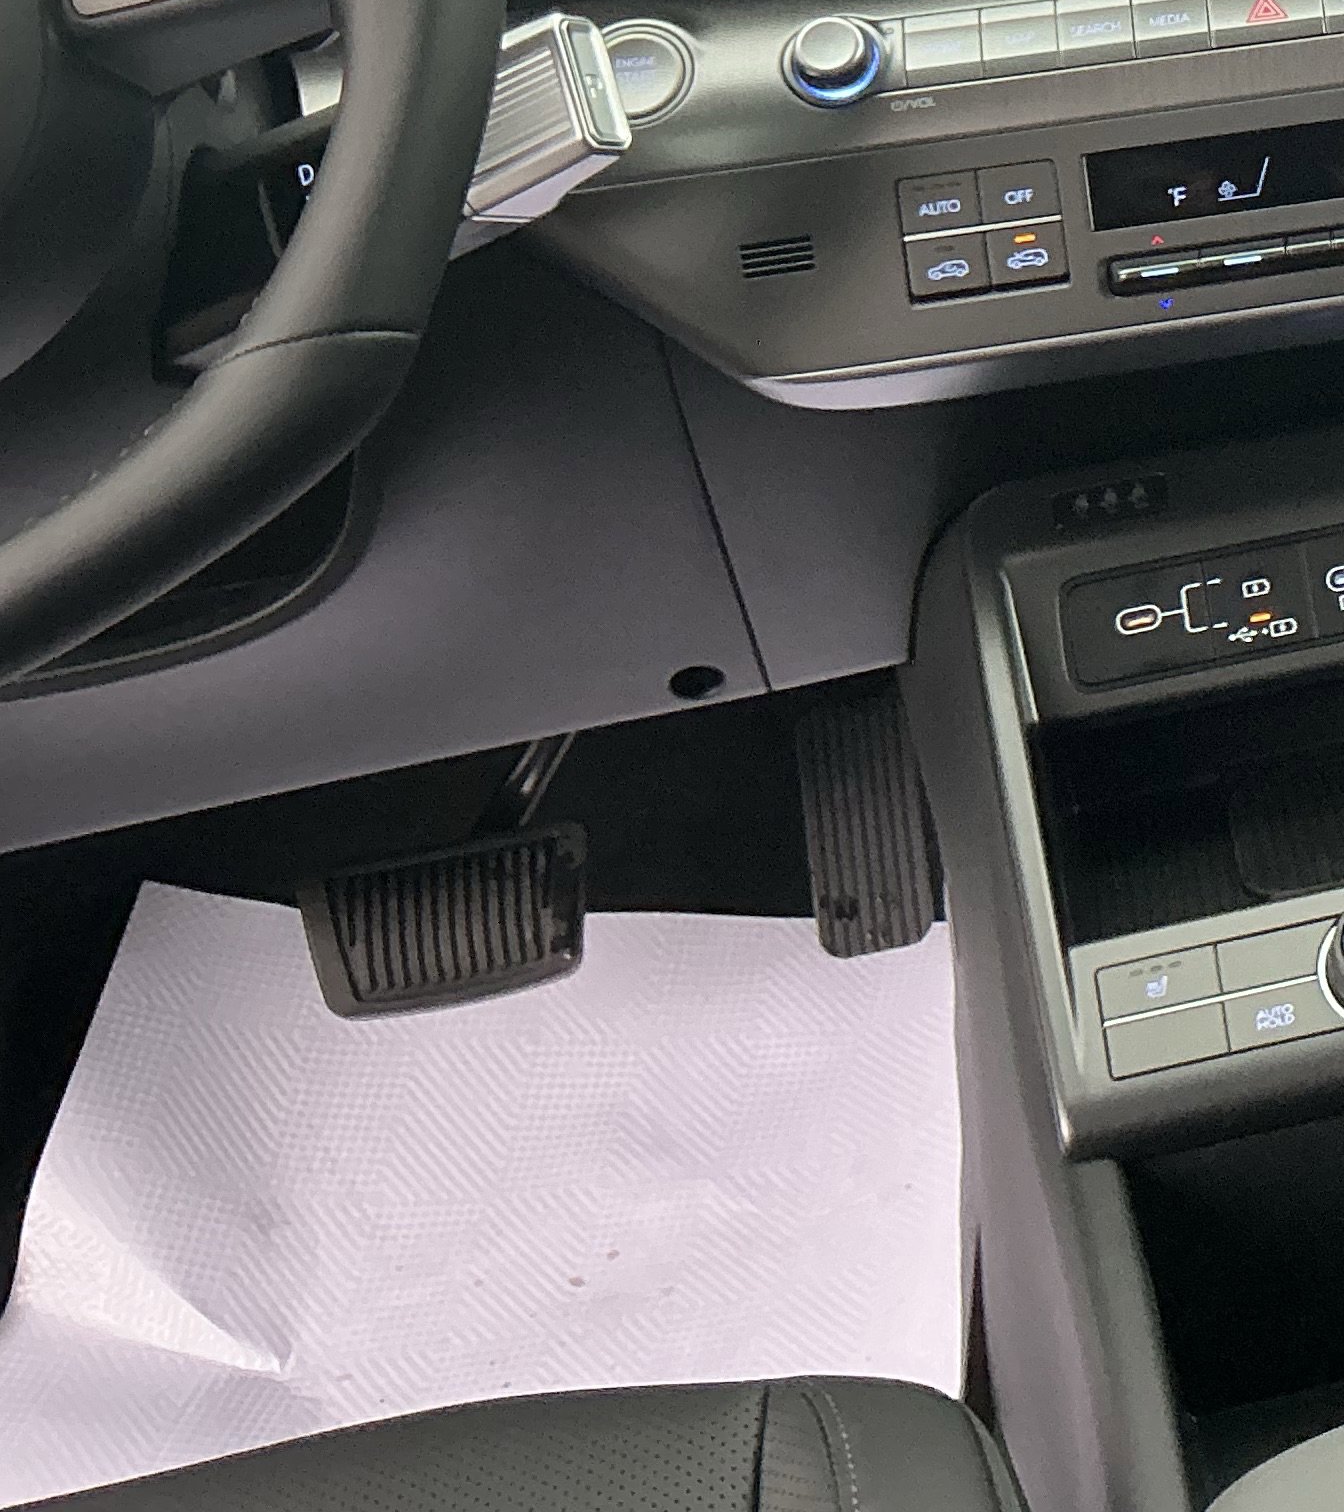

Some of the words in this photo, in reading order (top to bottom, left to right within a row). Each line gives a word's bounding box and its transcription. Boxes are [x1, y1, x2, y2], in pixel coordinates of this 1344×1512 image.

[1149, 12, 1191, 28] MEDIA
[297, 163, 315, 186] D
[1004, 188, 1034, 205] OFF
[918, 198, 961, 217] AUTO
[1256, 1003, 1294, 1020] AUTO
[1256, 1013, 1296, 1031] HOLD
